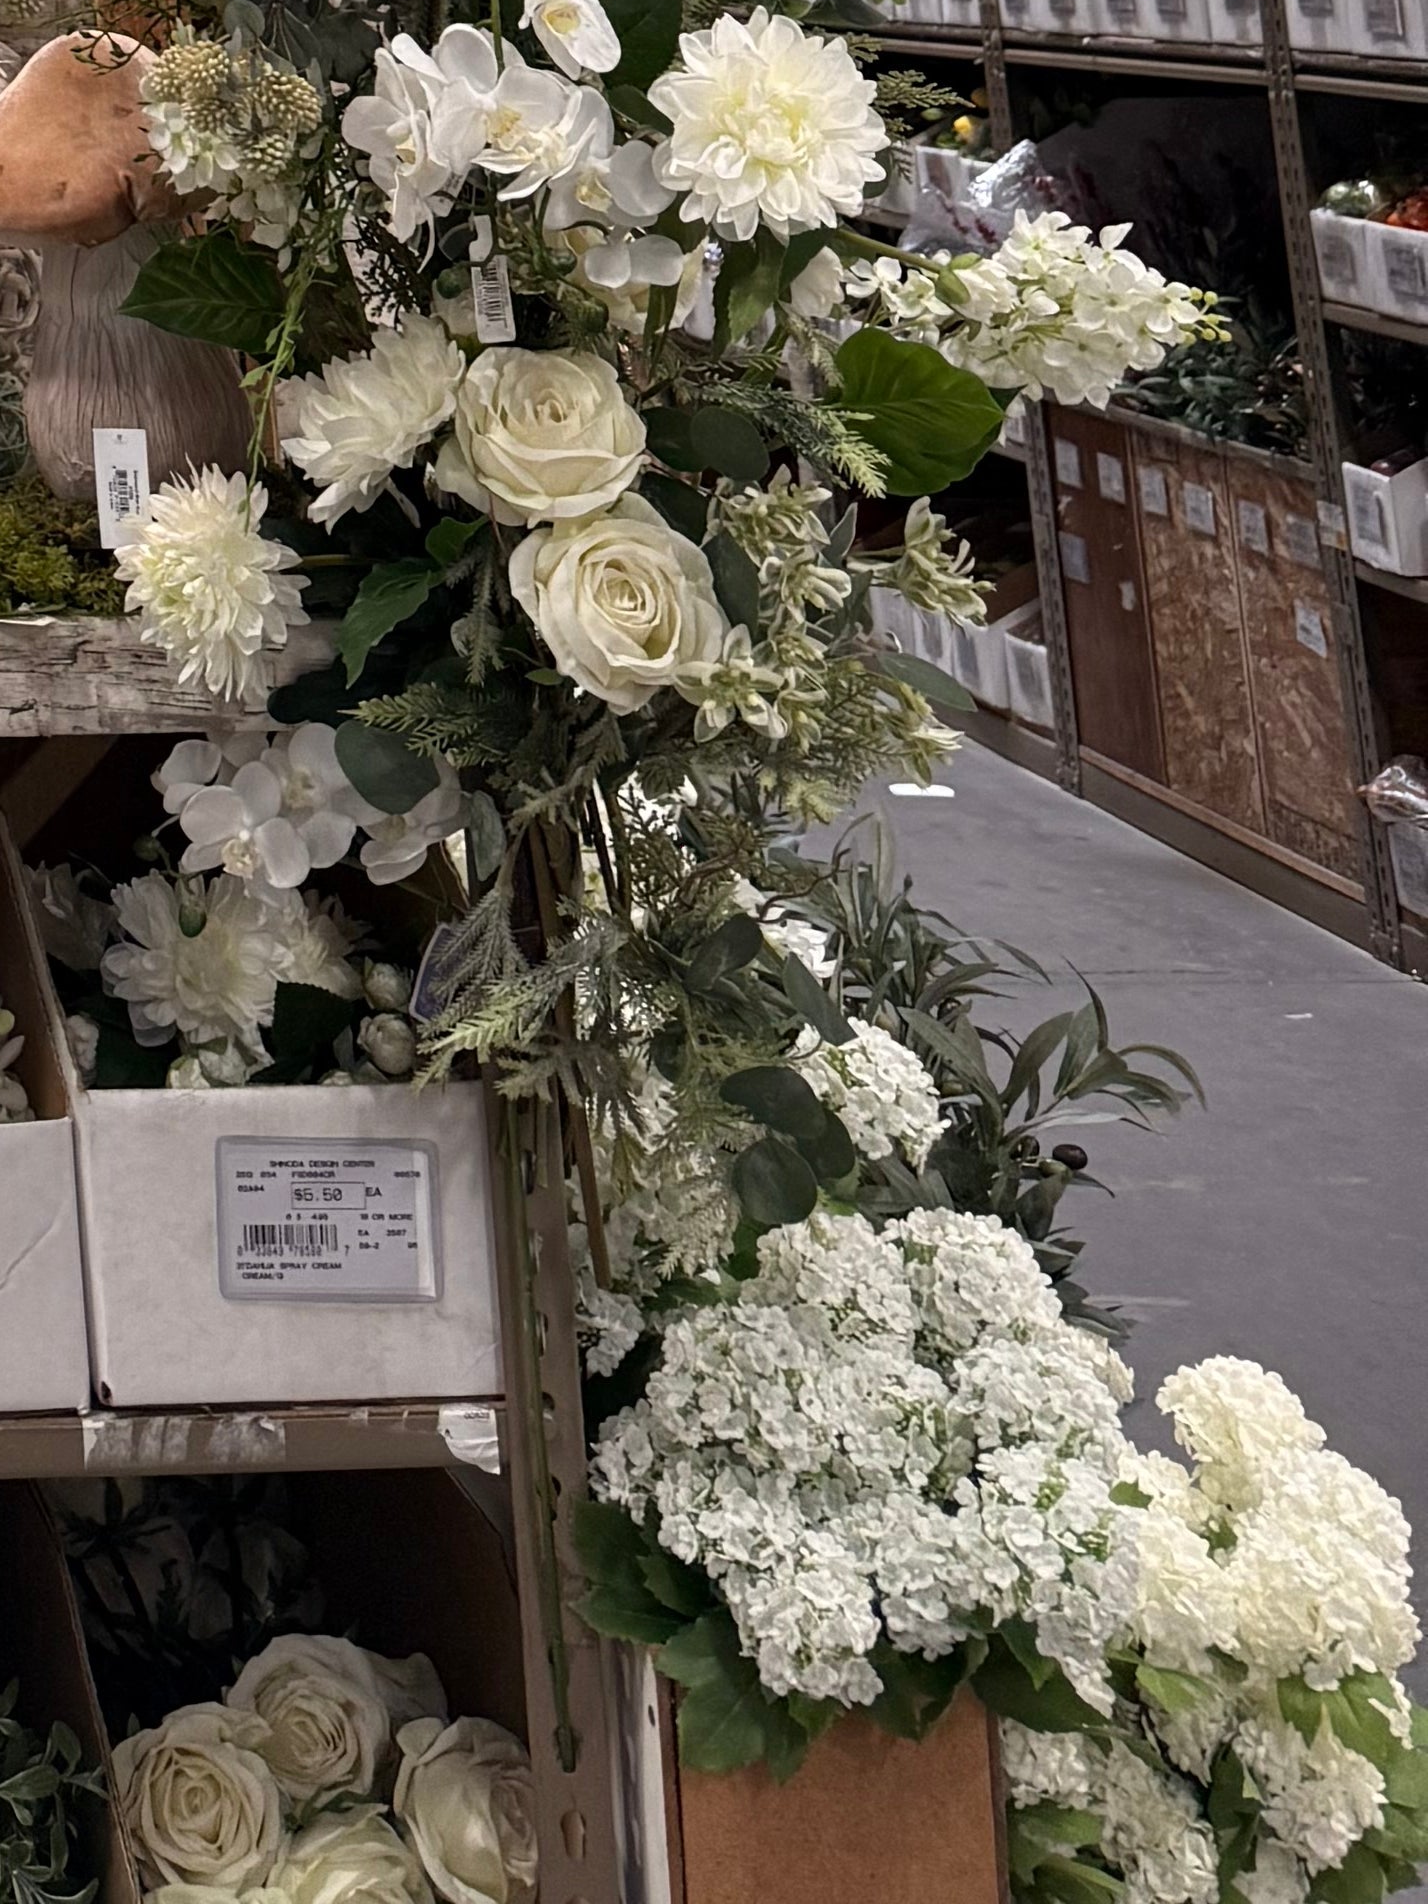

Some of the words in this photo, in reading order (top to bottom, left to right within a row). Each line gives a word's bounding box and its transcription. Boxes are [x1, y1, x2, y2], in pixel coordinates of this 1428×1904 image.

[309, 1160, 339, 1169] DESIGN
[343, 1160, 375, 1169] CENTER
[294, 1188, 343, 1202] $5.50
[365, 1187, 383, 1198] EA
[312, 1262, 342, 1271] CREAM
